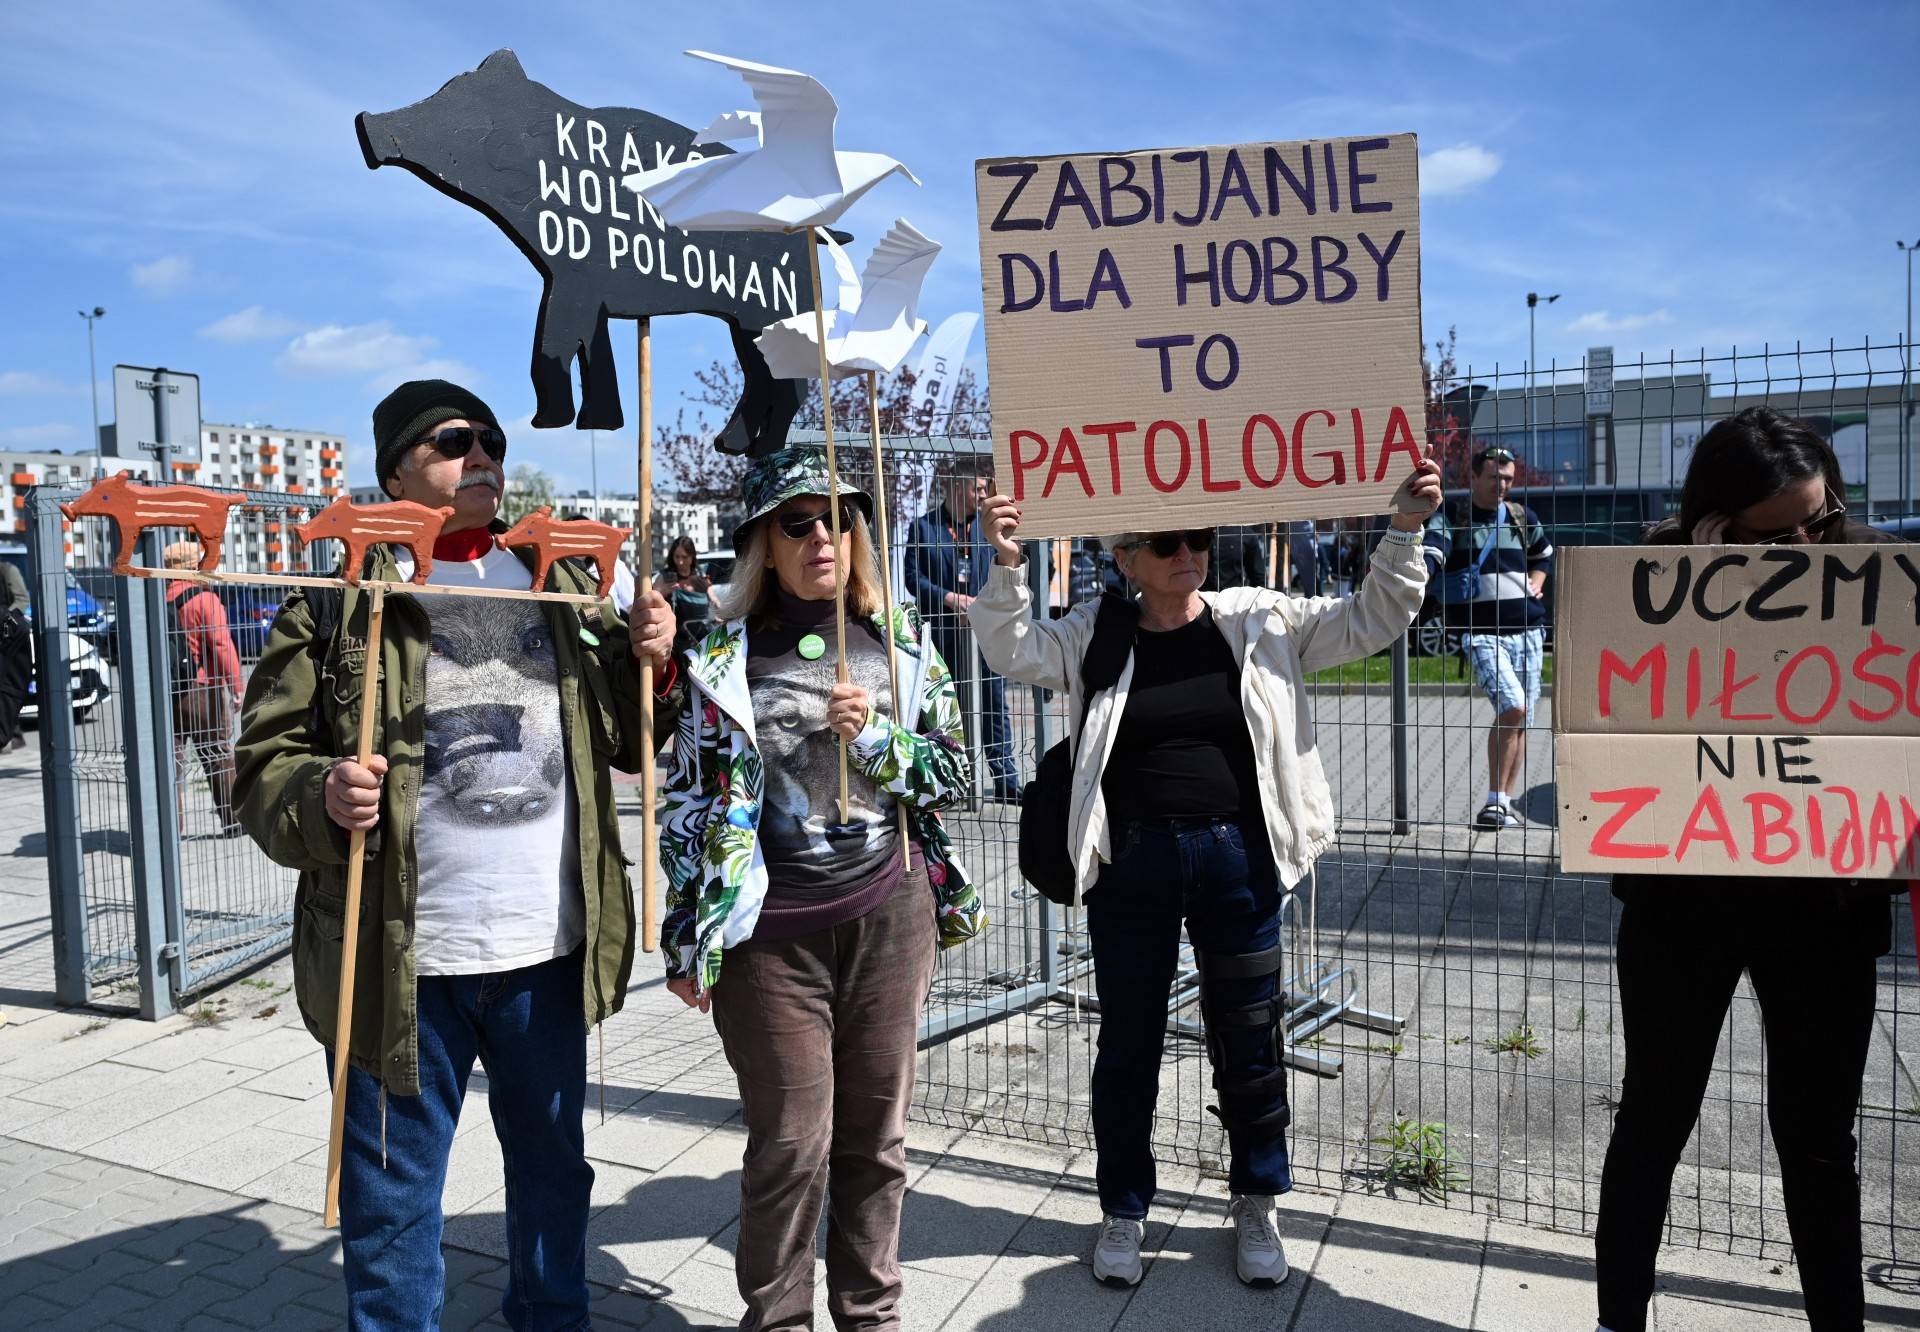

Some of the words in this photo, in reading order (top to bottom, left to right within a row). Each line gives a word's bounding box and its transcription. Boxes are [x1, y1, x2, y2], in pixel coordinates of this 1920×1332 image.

[556, 112, 704, 174] KRAK
[538, 159, 689, 237] WOLN
[988, 138, 1393, 232] ZABIJANIE
[539, 210, 592, 261] OD
[607, 226, 798, 317] POLOWAŃ
[998, 247, 1132, 313] DLA
[1173, 229, 1406, 308] HOBBY
[1135, 333, 1240, 393] TO
[1009, 406, 1421, 501] PATOLOGIA
[1696, 735, 1822, 784] NIE
